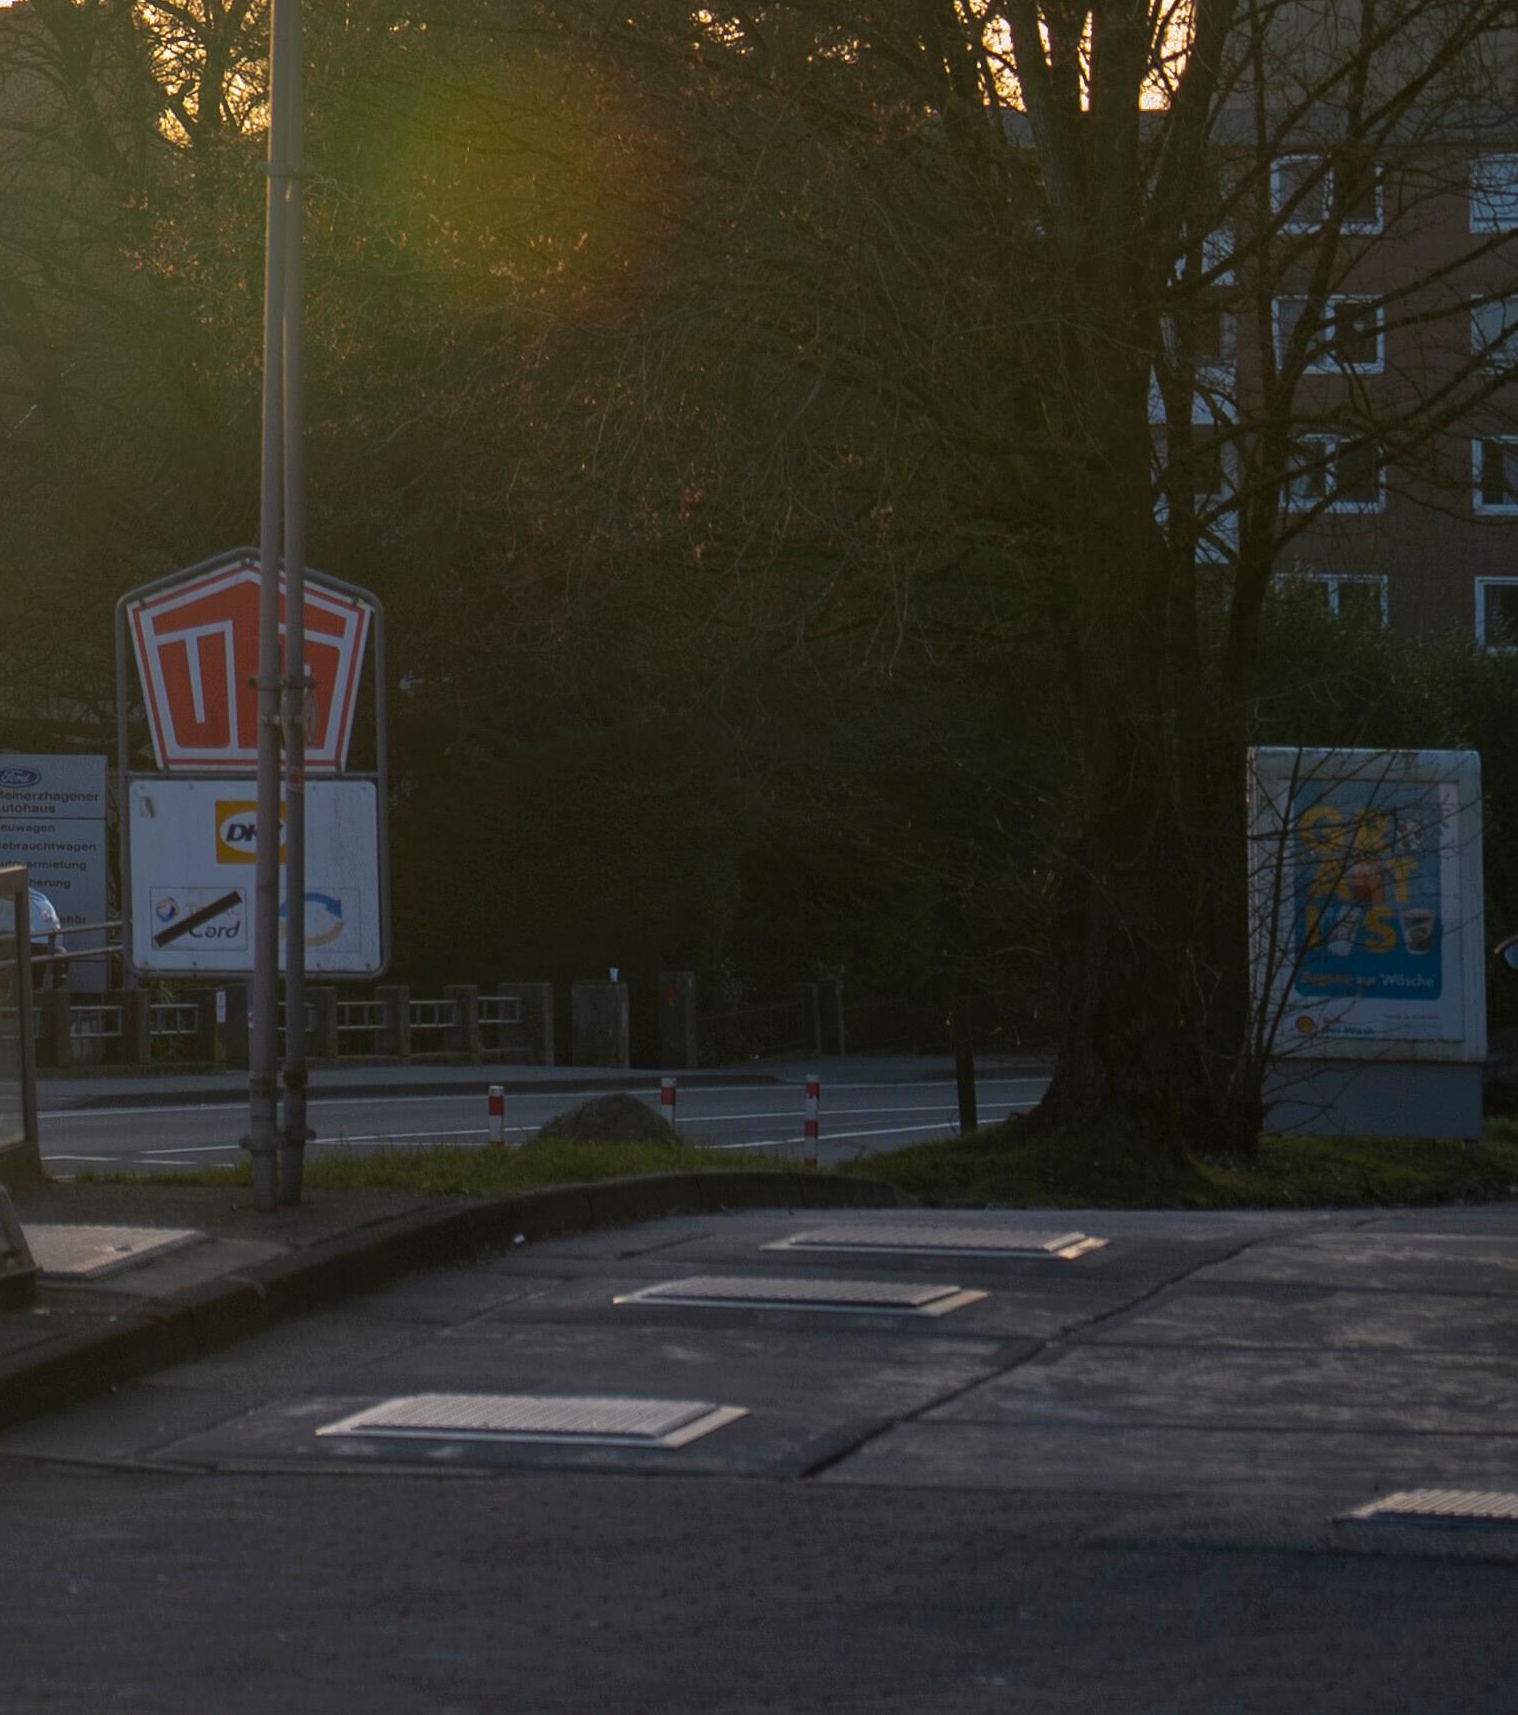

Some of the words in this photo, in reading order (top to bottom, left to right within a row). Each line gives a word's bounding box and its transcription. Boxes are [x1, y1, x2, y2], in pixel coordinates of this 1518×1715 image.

[1, 770, 30, 784] Ford
[29, 878, 71, 889] herung
[60, 914, 87, 925] ehör
[188, 920, 241, 939] Card
